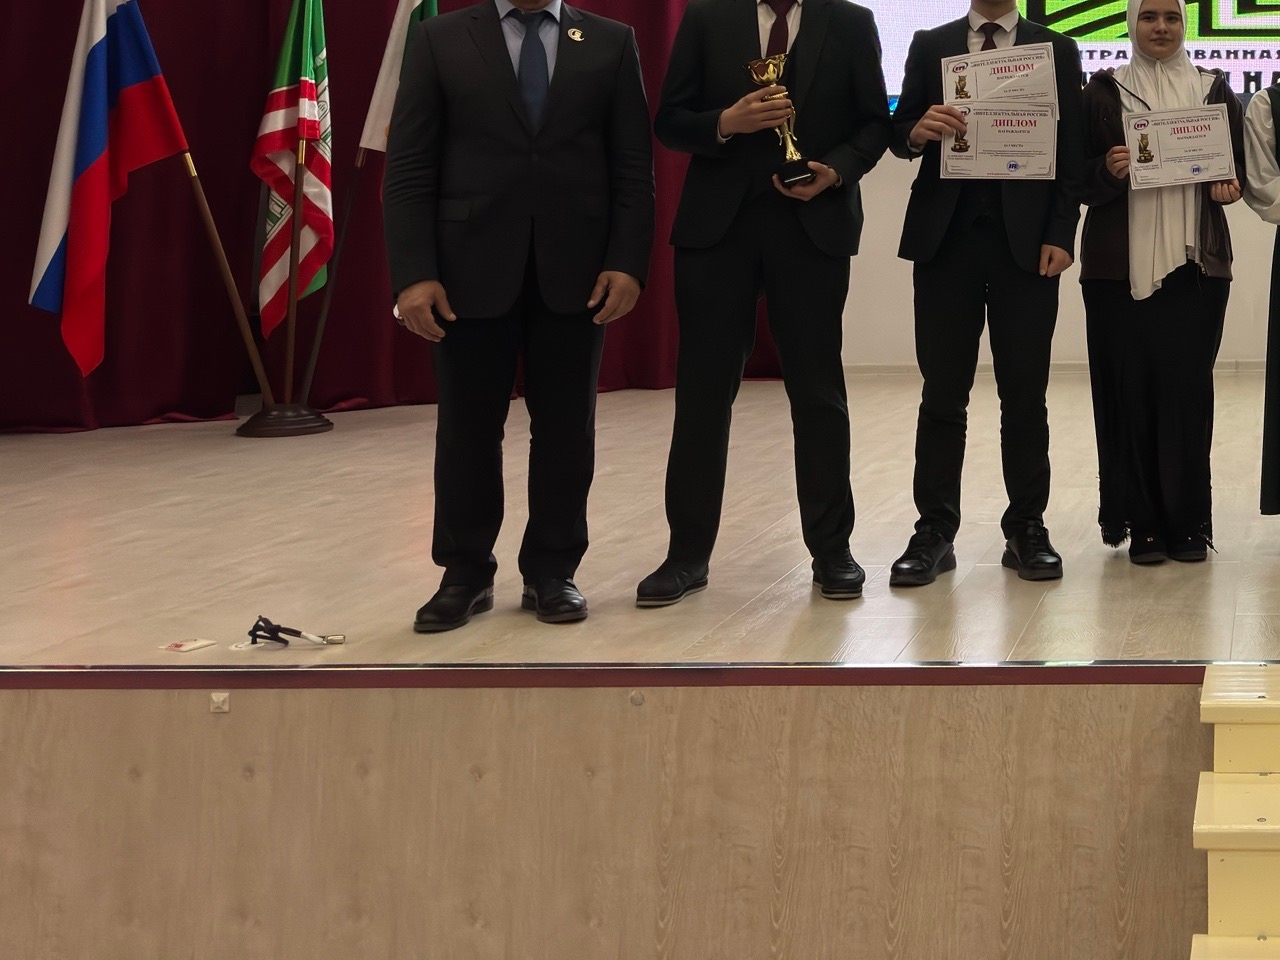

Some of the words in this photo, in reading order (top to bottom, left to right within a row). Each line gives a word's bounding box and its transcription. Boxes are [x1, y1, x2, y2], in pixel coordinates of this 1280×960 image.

[989, 63, 1035, 76] ДИПЛОМ
[991, 119, 1037, 128] ДИПЛОМ
[1170, 123, 1212, 136] ДИПЛОМ
